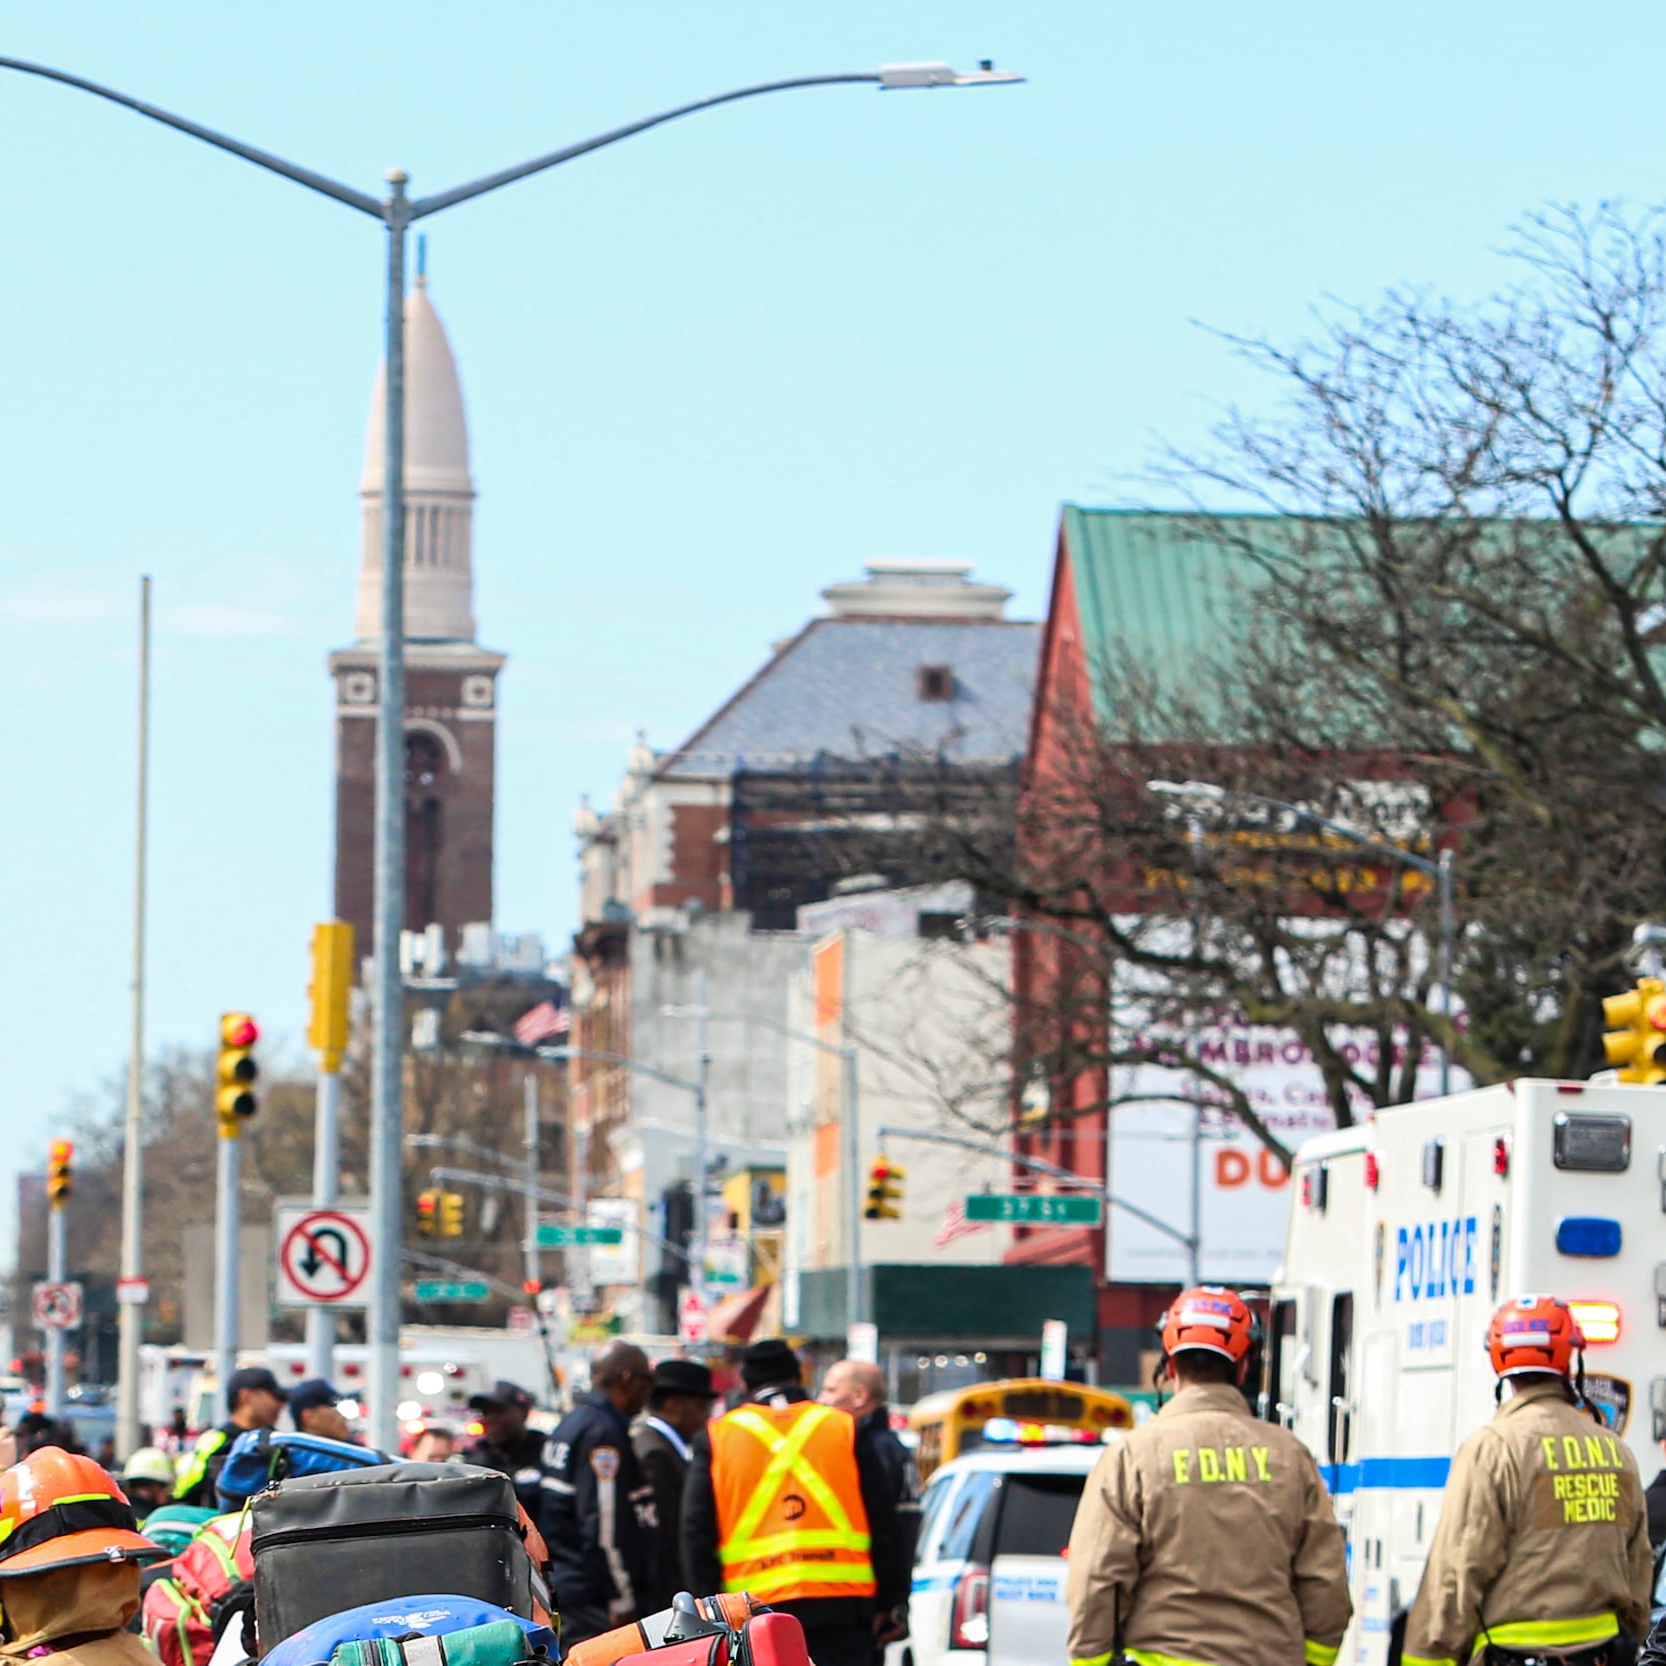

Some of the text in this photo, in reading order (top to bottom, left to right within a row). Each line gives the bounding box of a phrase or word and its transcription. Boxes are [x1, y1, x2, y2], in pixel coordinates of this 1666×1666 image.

[1395, 1216, 1477, 1302] POLICE
[1553, 1472, 1620, 1500] RESCUE
[1563, 1497, 1617, 1524] MEDIC
